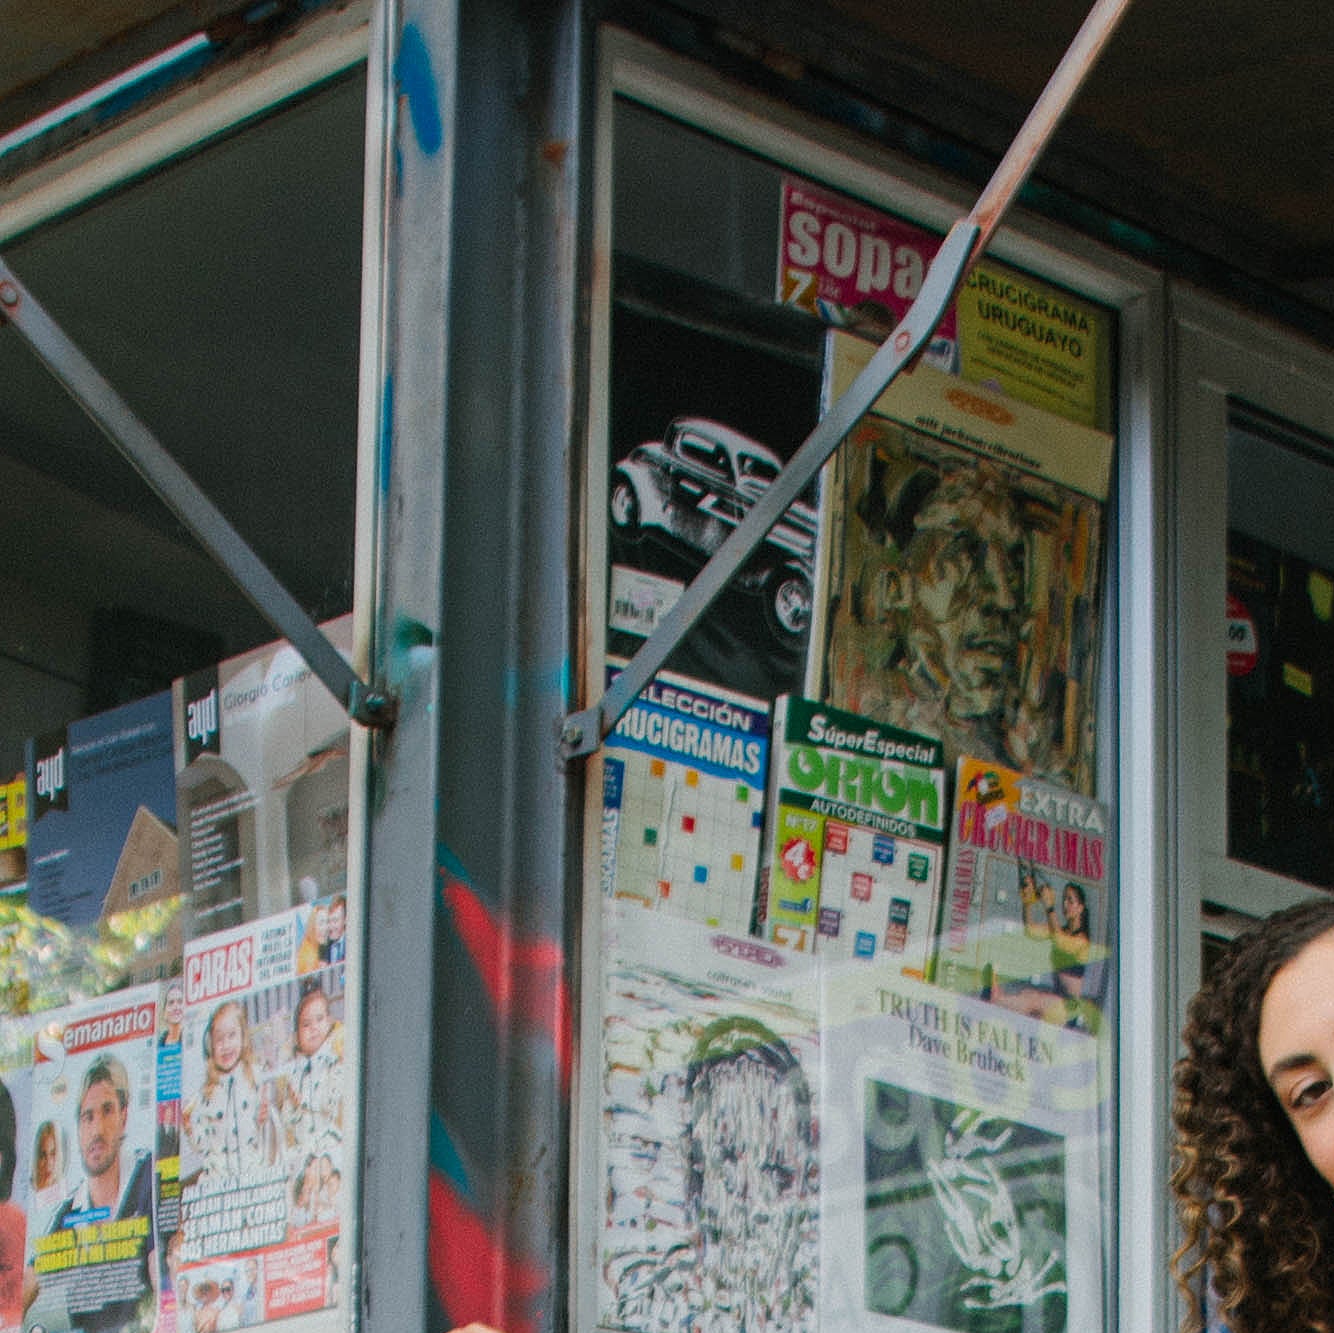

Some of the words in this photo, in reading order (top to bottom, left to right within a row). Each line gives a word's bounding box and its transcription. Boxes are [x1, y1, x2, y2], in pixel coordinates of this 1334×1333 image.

[977, 301, 1083, 359] URUGUAYO
[613, 706, 761, 775] RUCIGRAMAS
[810, 798, 918, 840] AUTODEFINIDOS
[1020, 785, 1102, 832] EXTRA
[188, 940, 252, 1004] CARAS
[38, 1008, 151, 1072] Semanario
[878, 989, 949, 1030] TRUTH
[975, 1018, 1055, 1063] FALLEN
[909, 1022, 949, 1056] Dave
[956, 1039, 1026, 1081] Brubeck
